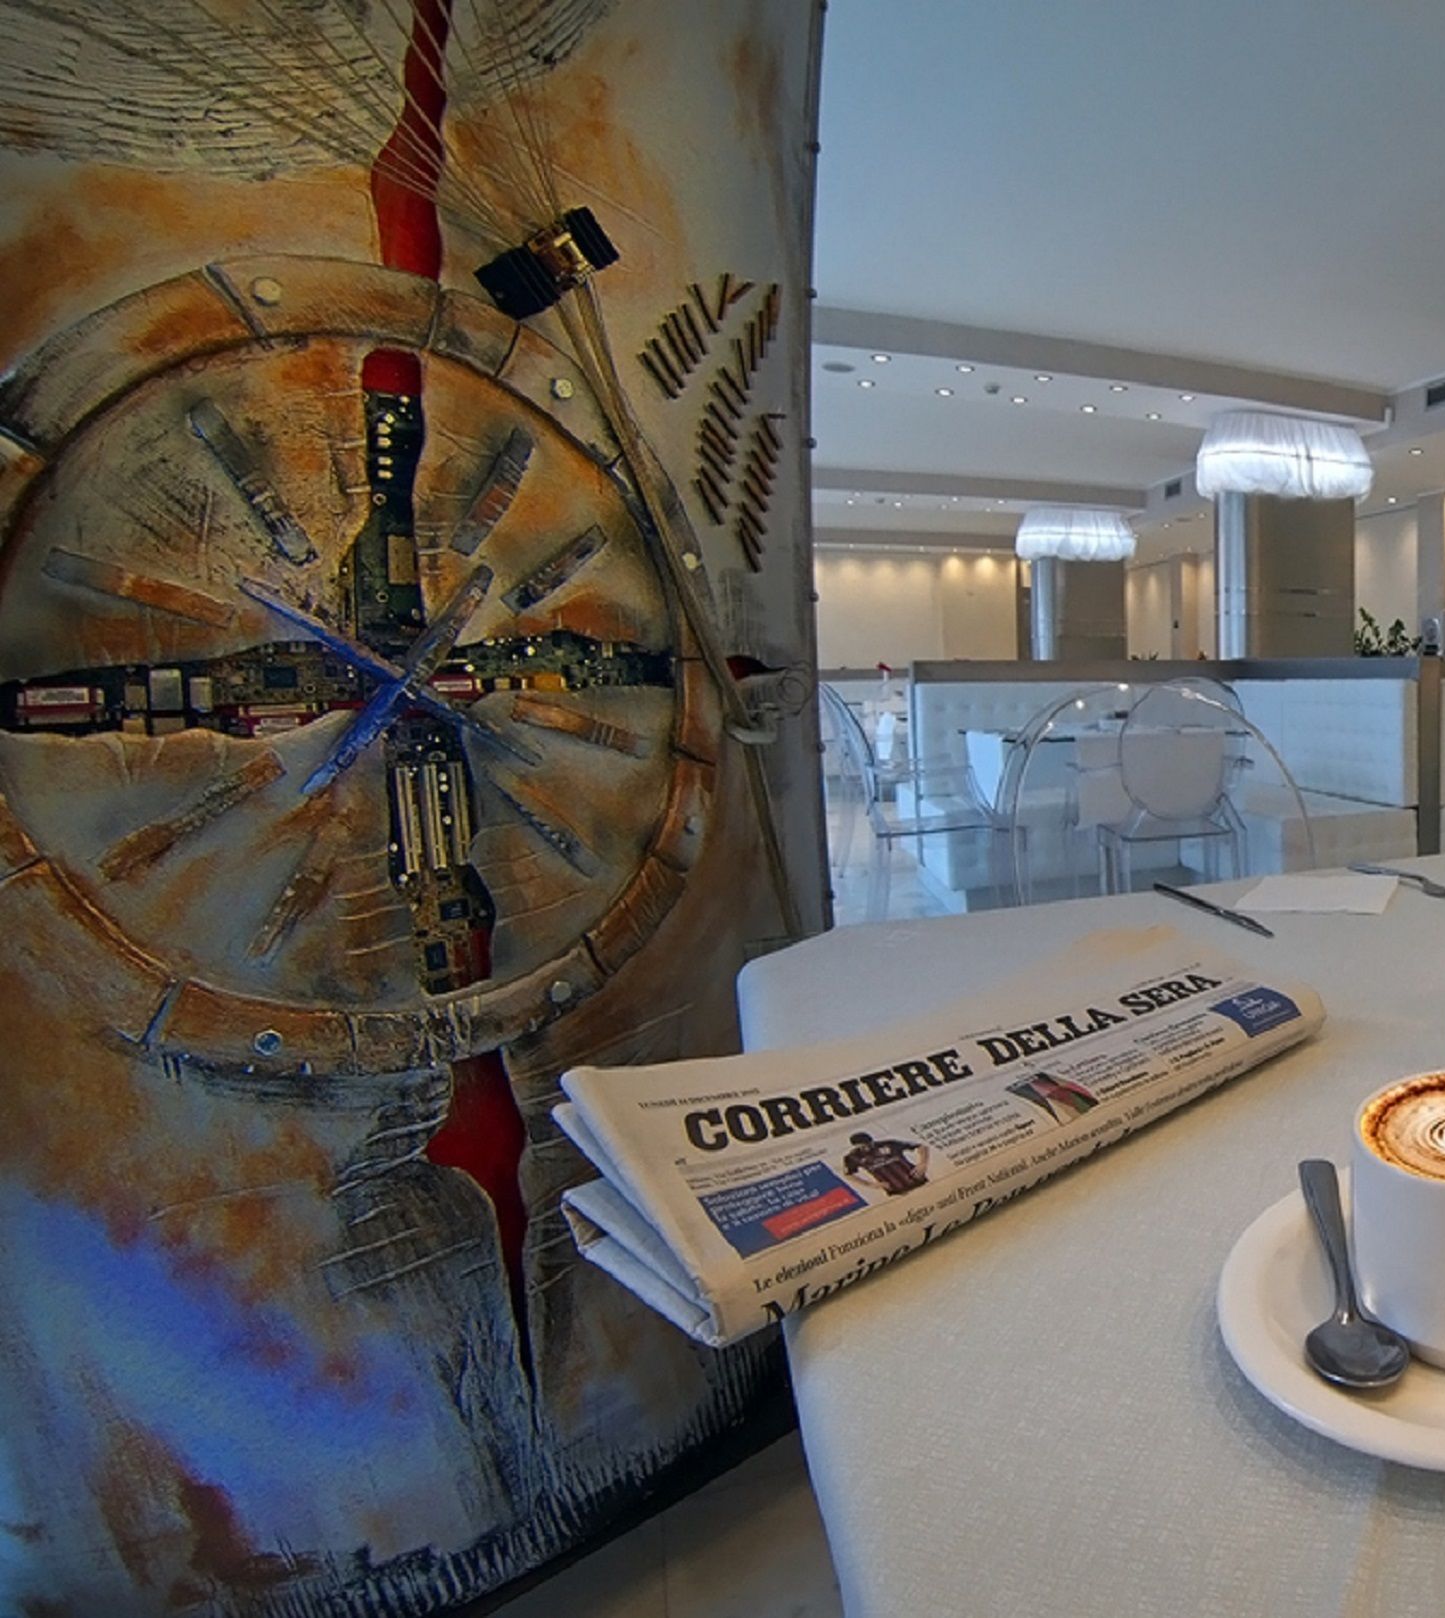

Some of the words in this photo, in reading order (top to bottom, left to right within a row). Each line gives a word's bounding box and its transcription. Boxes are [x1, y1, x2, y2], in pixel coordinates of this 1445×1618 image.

[684, 1048, 973, 1151] CORRIERE
[977, 1007, 1127, 1066] DELLA
[1118, 974, 1222, 1016] SERA
[776, 1254, 828, 1285] elezioni
